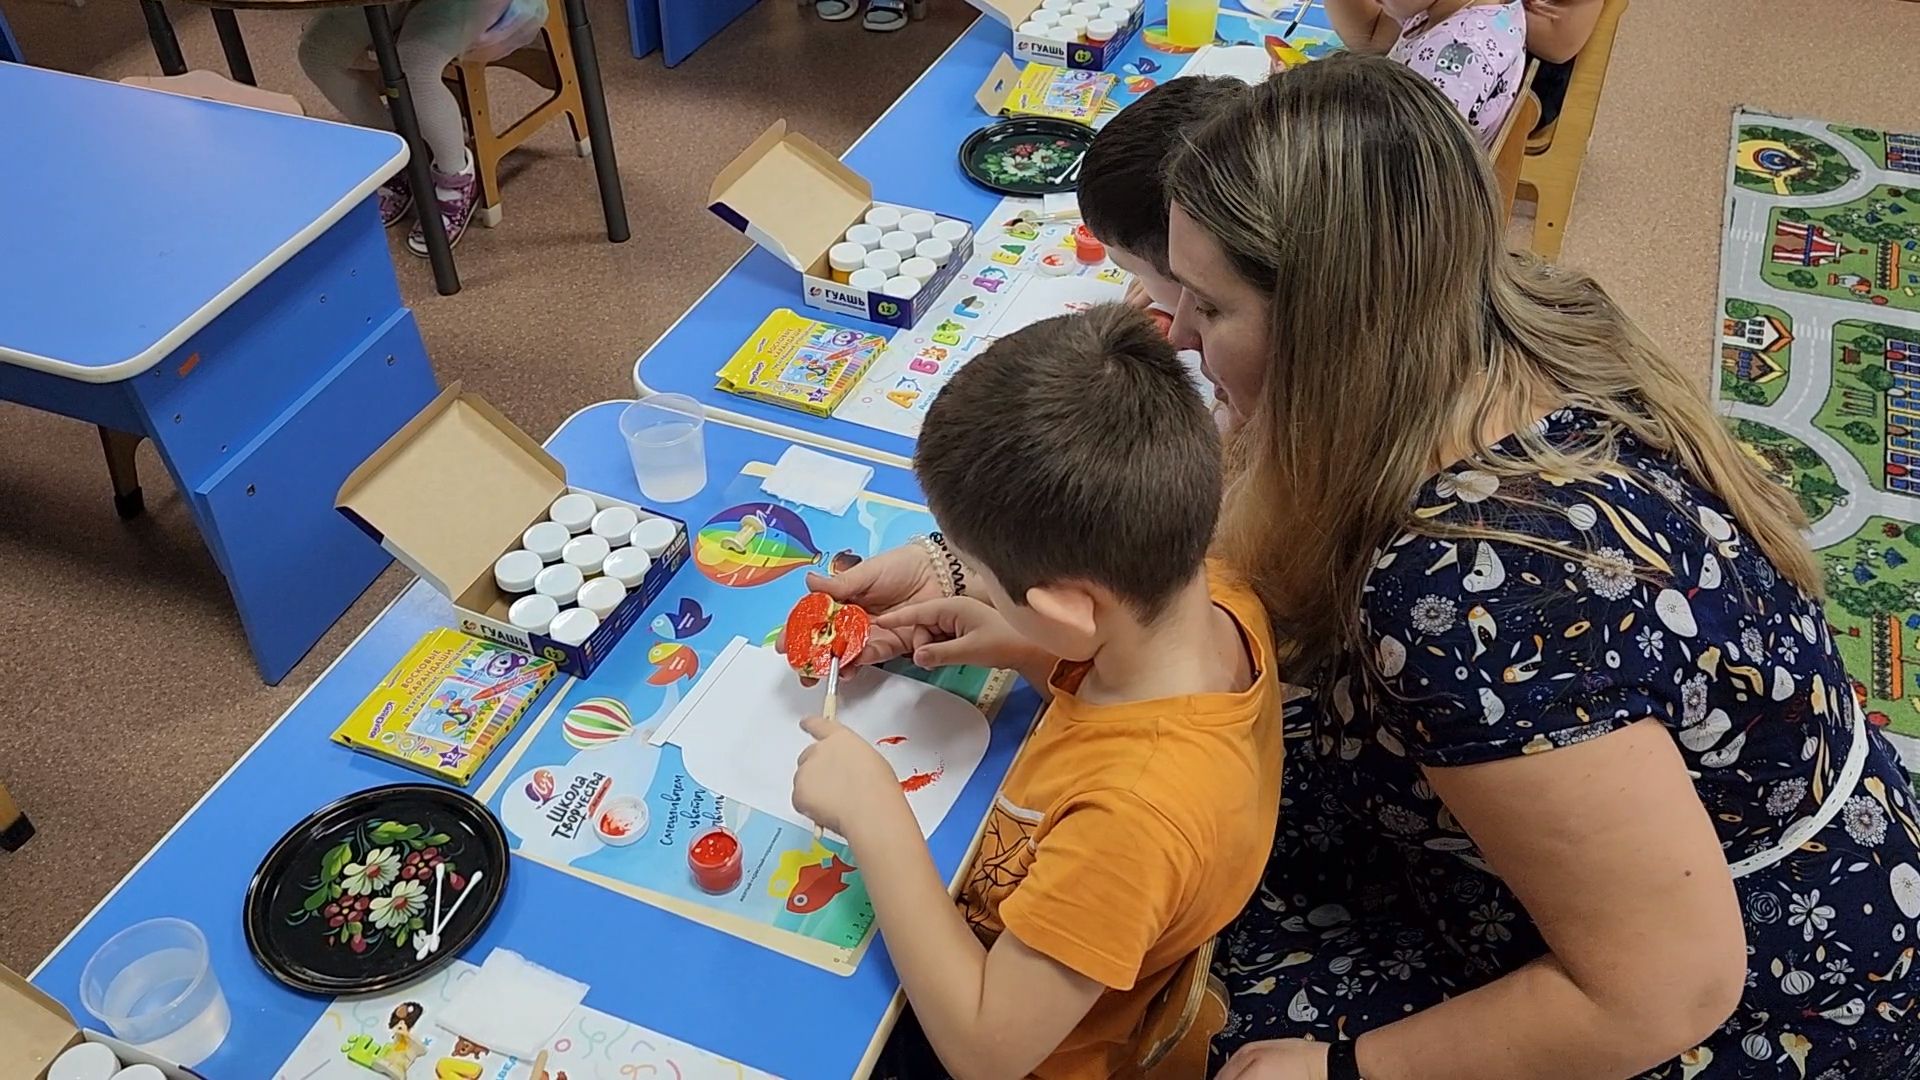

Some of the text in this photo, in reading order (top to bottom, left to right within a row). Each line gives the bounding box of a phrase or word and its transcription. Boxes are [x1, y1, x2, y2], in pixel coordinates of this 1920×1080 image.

[1031, 42, 1064, 55] ГУАШЬ
[825, 288, 865, 306] ГУАШЬ
[880, 304, 892, 313] 12
[910, 358, 939, 374] Б
[887, 391, 919, 408] А
[480, 624, 529, 648] ГУАШЬ
[401, 649, 441, 689] ВОСКОВЫЕ
[408, 649, 454, 696] КАРАНДАШИ
[660, 774, 684, 846] Смешиваем
[680, 789, 706, 828] цвета
